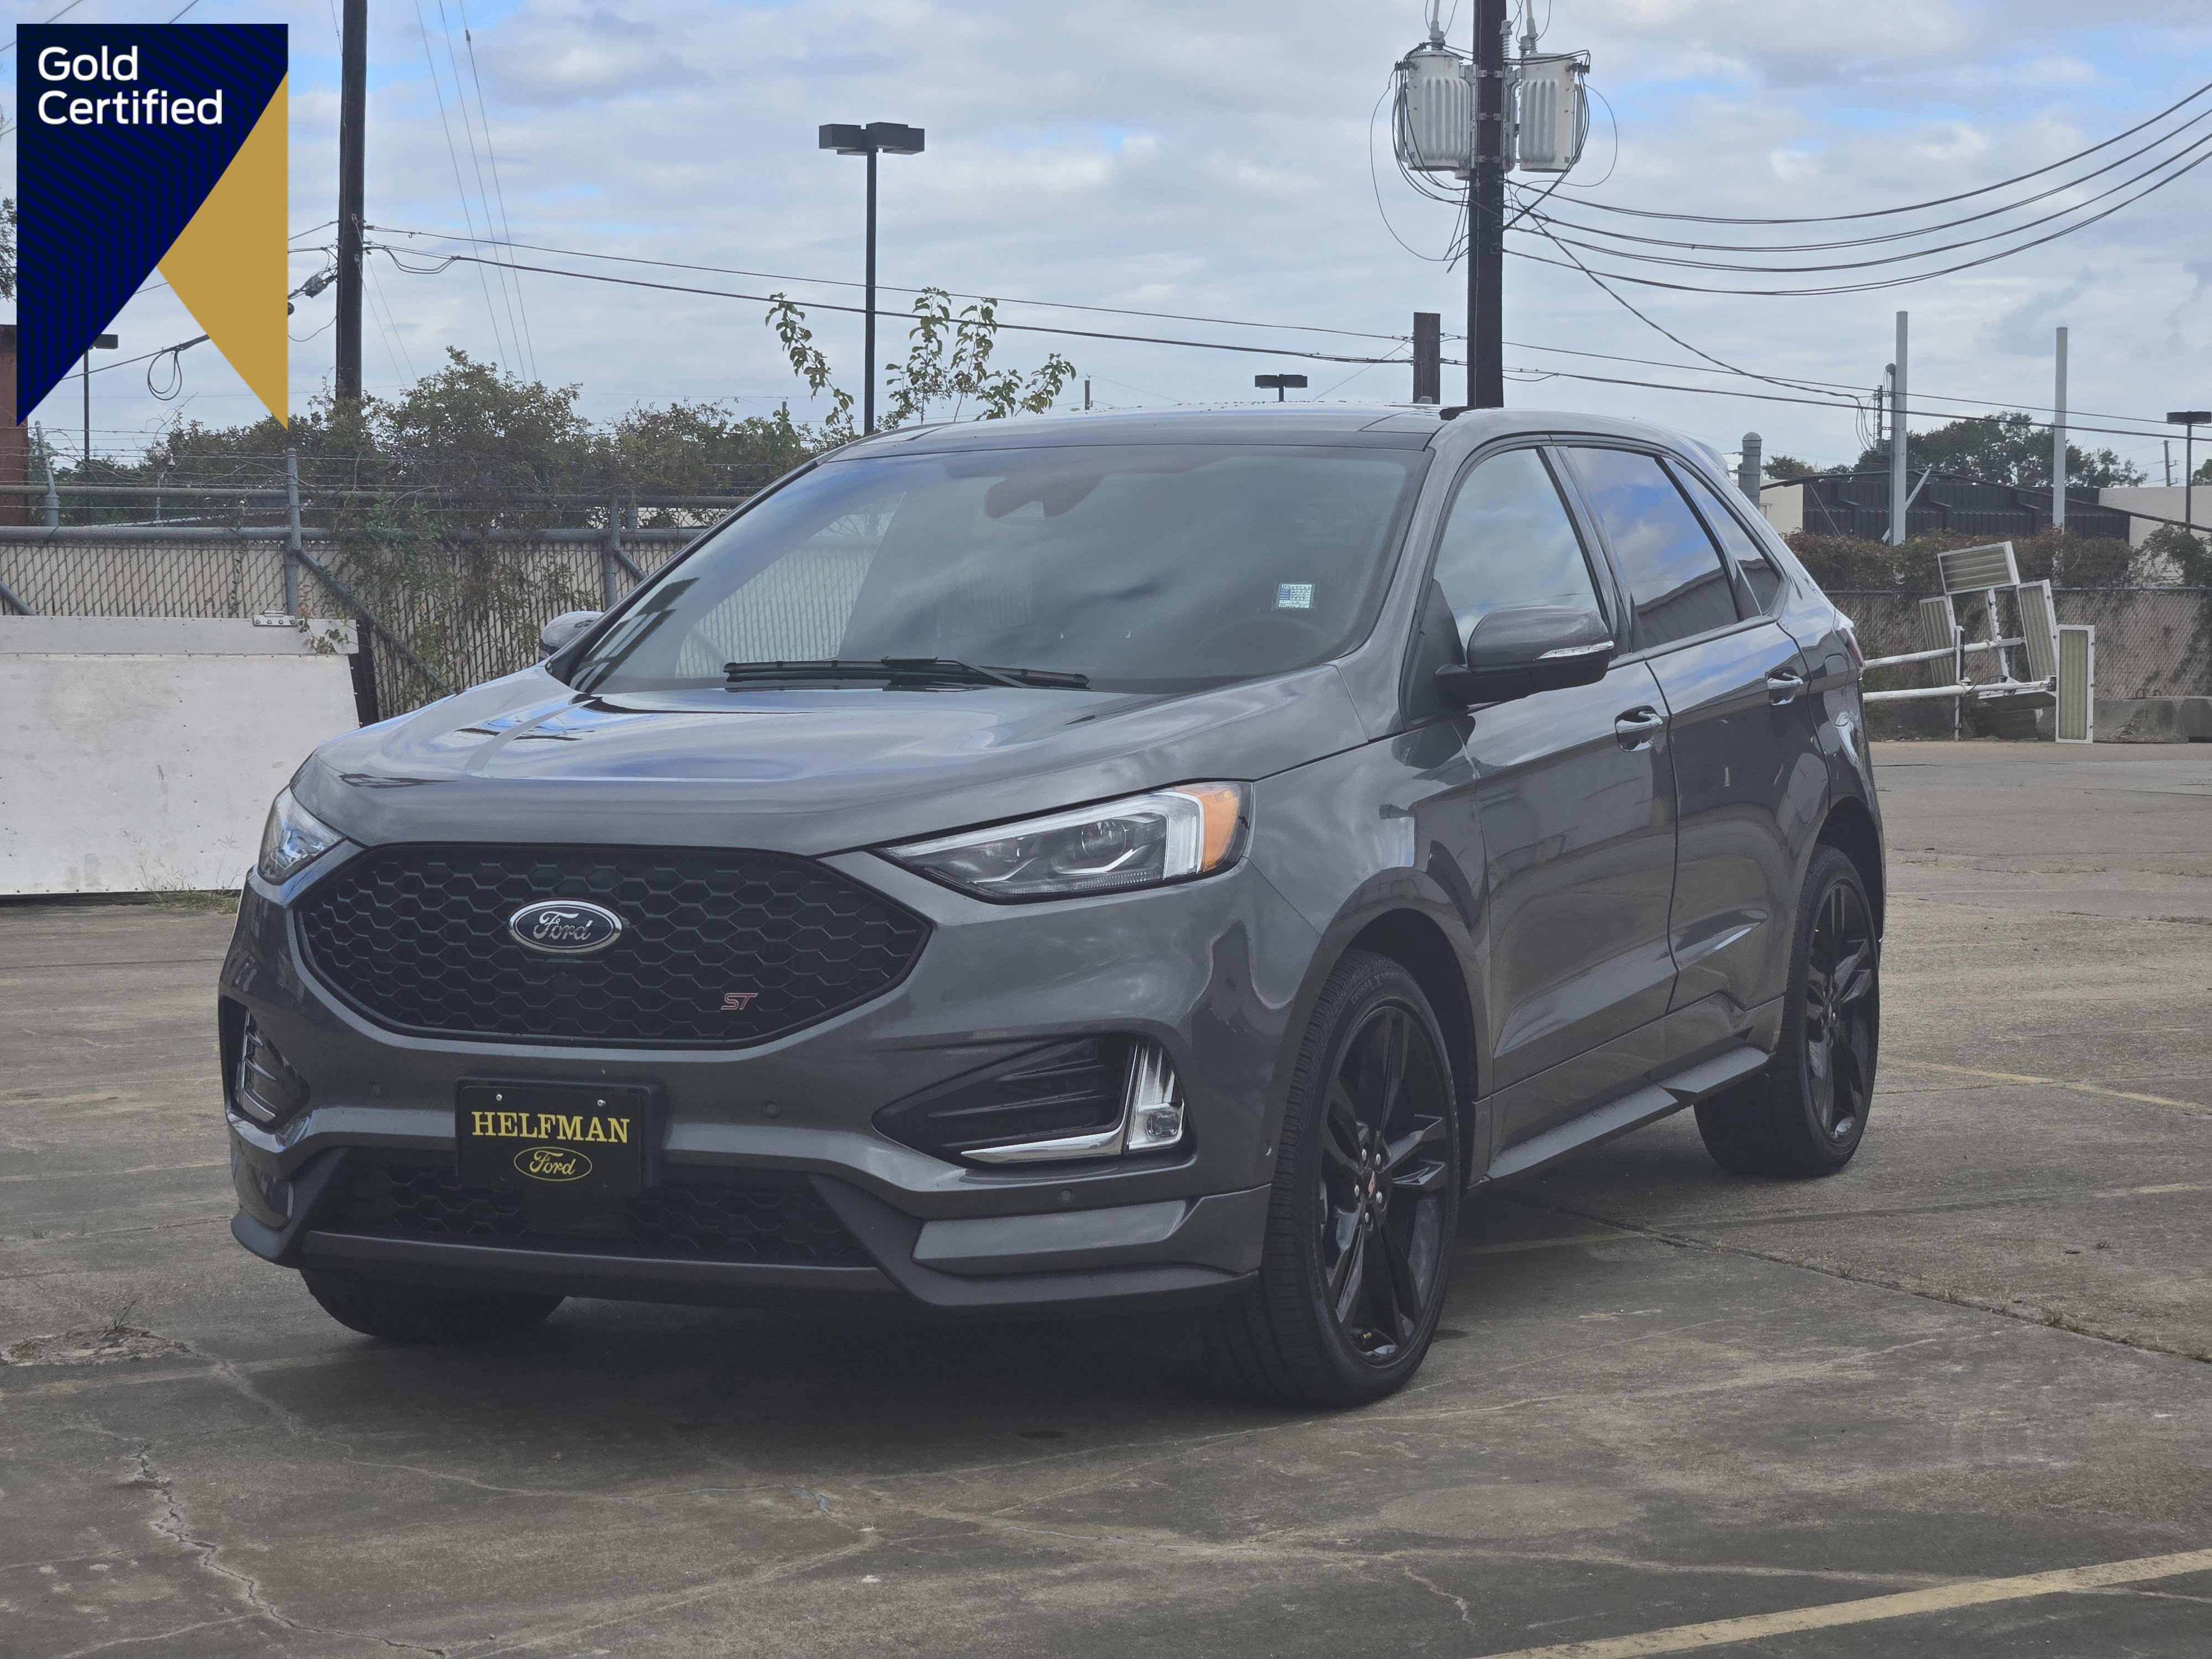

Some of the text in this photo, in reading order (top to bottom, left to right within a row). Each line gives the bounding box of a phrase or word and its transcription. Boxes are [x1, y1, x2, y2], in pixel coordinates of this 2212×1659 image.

[533, 911, 593, 940] Ford
[721, 993, 758, 1010] ST
[471, 1111, 630, 1143] HELFMAN
[529, 1150, 576, 1175] Ford
